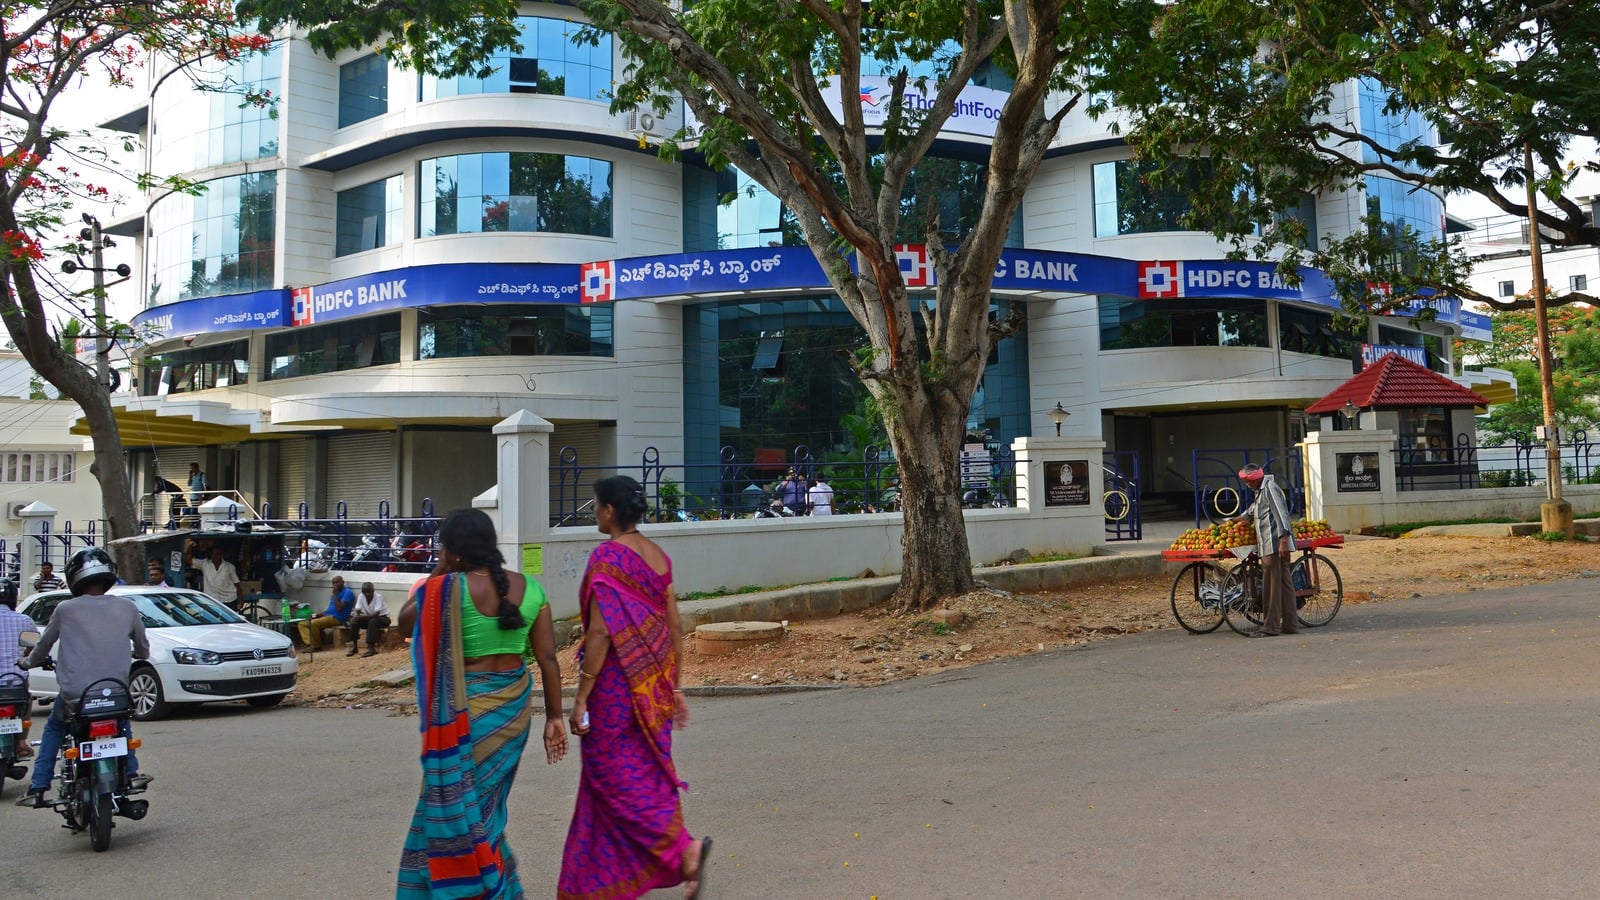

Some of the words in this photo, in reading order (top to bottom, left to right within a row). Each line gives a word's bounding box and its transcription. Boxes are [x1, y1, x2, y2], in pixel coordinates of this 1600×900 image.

[904, 93, 1002, 120] ThoghtFoc
[719, 254, 782, 284] ಬ್ಯಾಂಕ್
[1015, 259, 1079, 282] BANK
[1188, 269, 1251, 288] HDFC
[315, 288, 353, 313] HDFC
[357, 279, 408, 305] BANK
[148, 313, 174, 331] BANK
[1400, 349, 1424, 366] BANK
